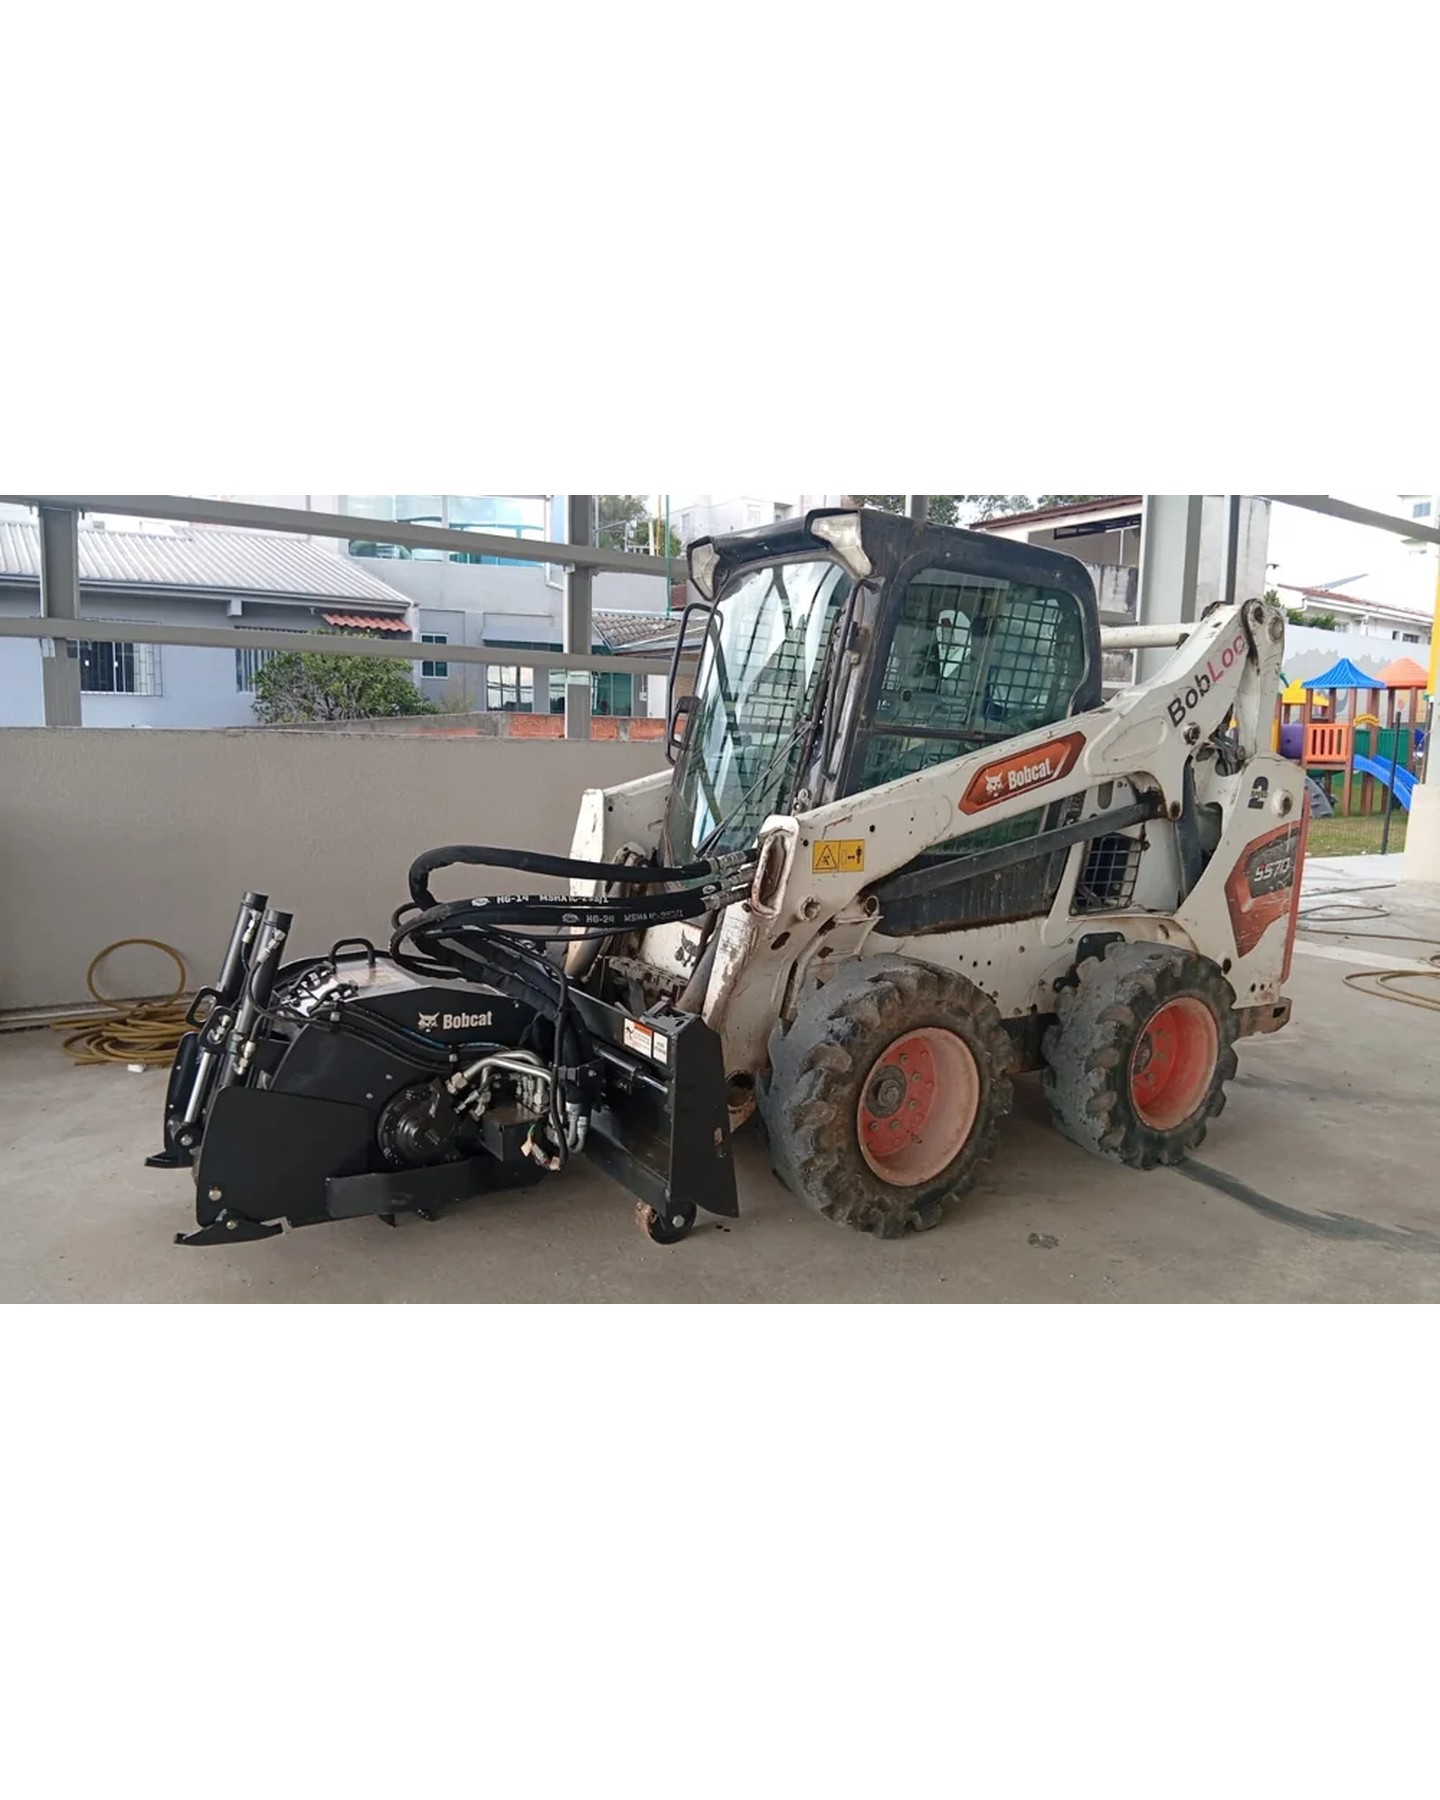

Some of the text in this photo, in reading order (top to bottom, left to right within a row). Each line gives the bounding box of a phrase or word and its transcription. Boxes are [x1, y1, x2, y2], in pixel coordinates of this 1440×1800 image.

[1007, 757, 1053, 790] Bobcat
[1253, 857, 1291, 882] S570
[443, 1011, 492, 1029] Bobcat
